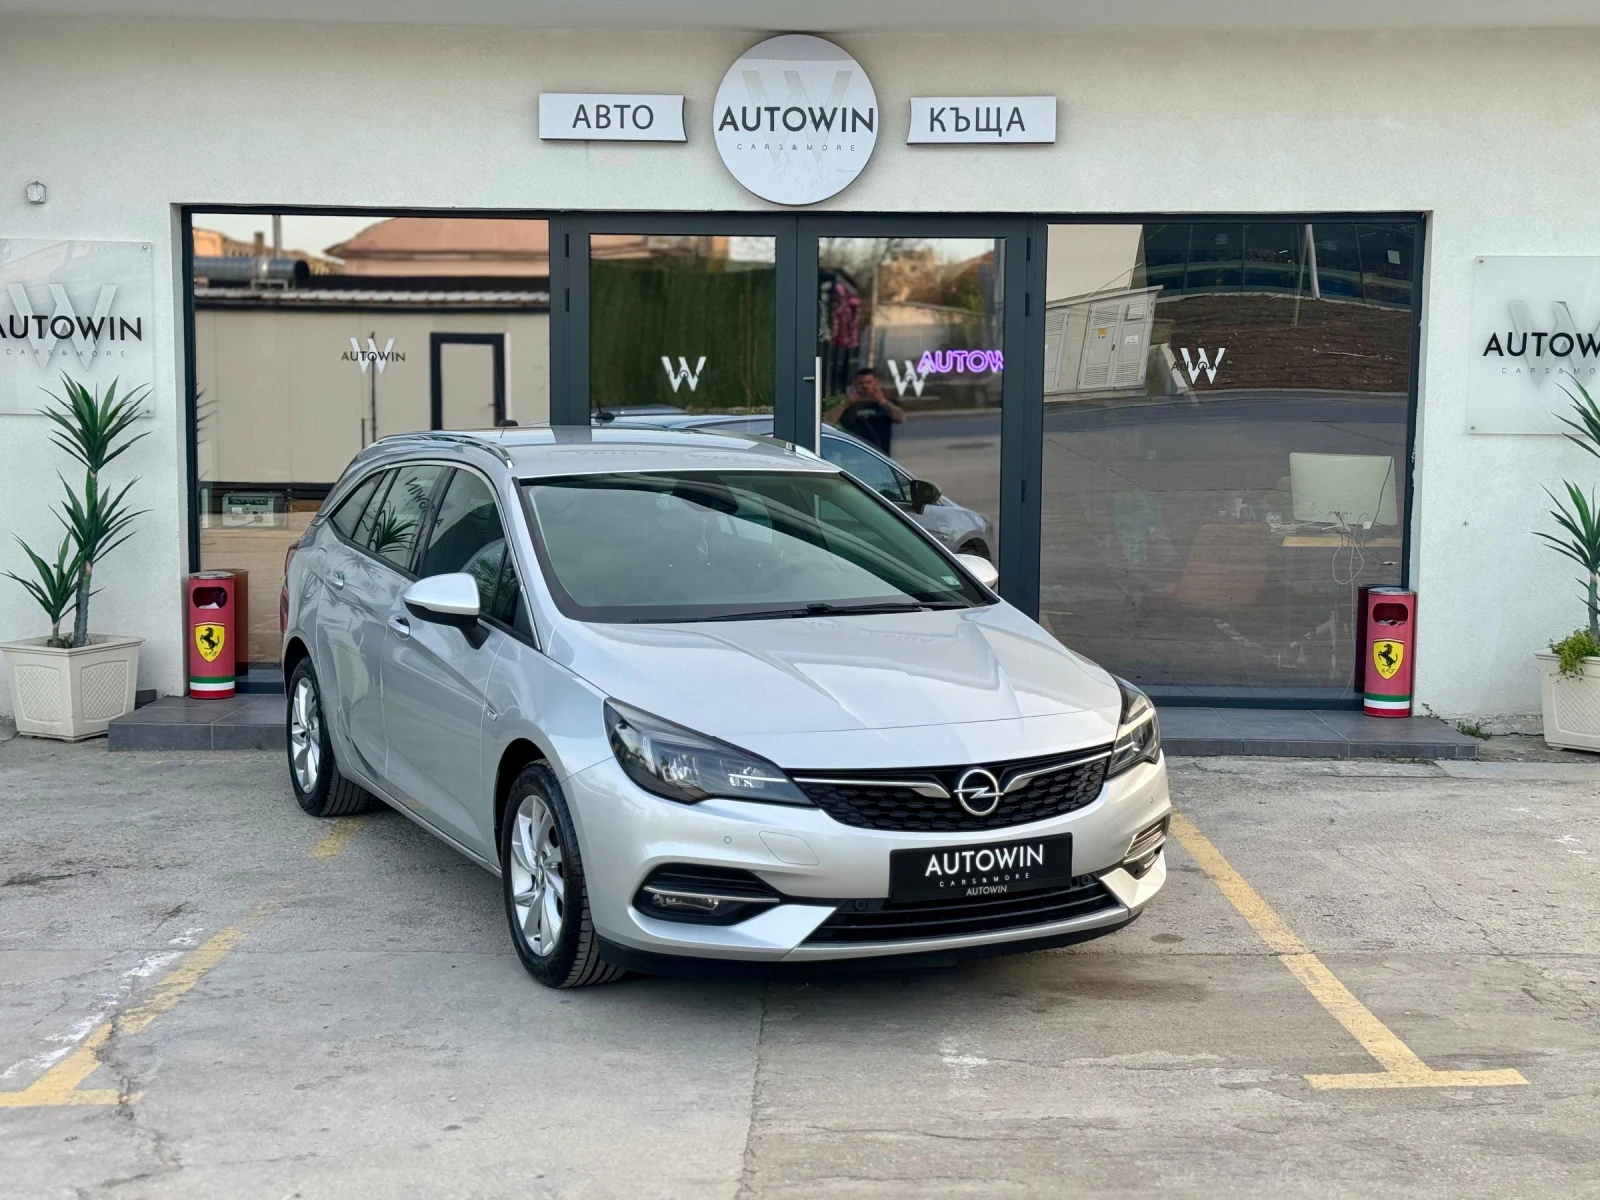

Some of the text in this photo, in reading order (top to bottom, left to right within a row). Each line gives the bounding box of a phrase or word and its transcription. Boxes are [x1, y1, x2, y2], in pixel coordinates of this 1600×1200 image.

[571, 103, 654, 130] АВТО
[718, 105, 874, 133] AUTOWIN
[929, 106, 1026, 138] КЪЩА
[341, 350, 406, 362] AUTOWIN
[925, 844, 1044, 877] AUTOWIN
[966, 885, 1008, 897] AUTOWIN
